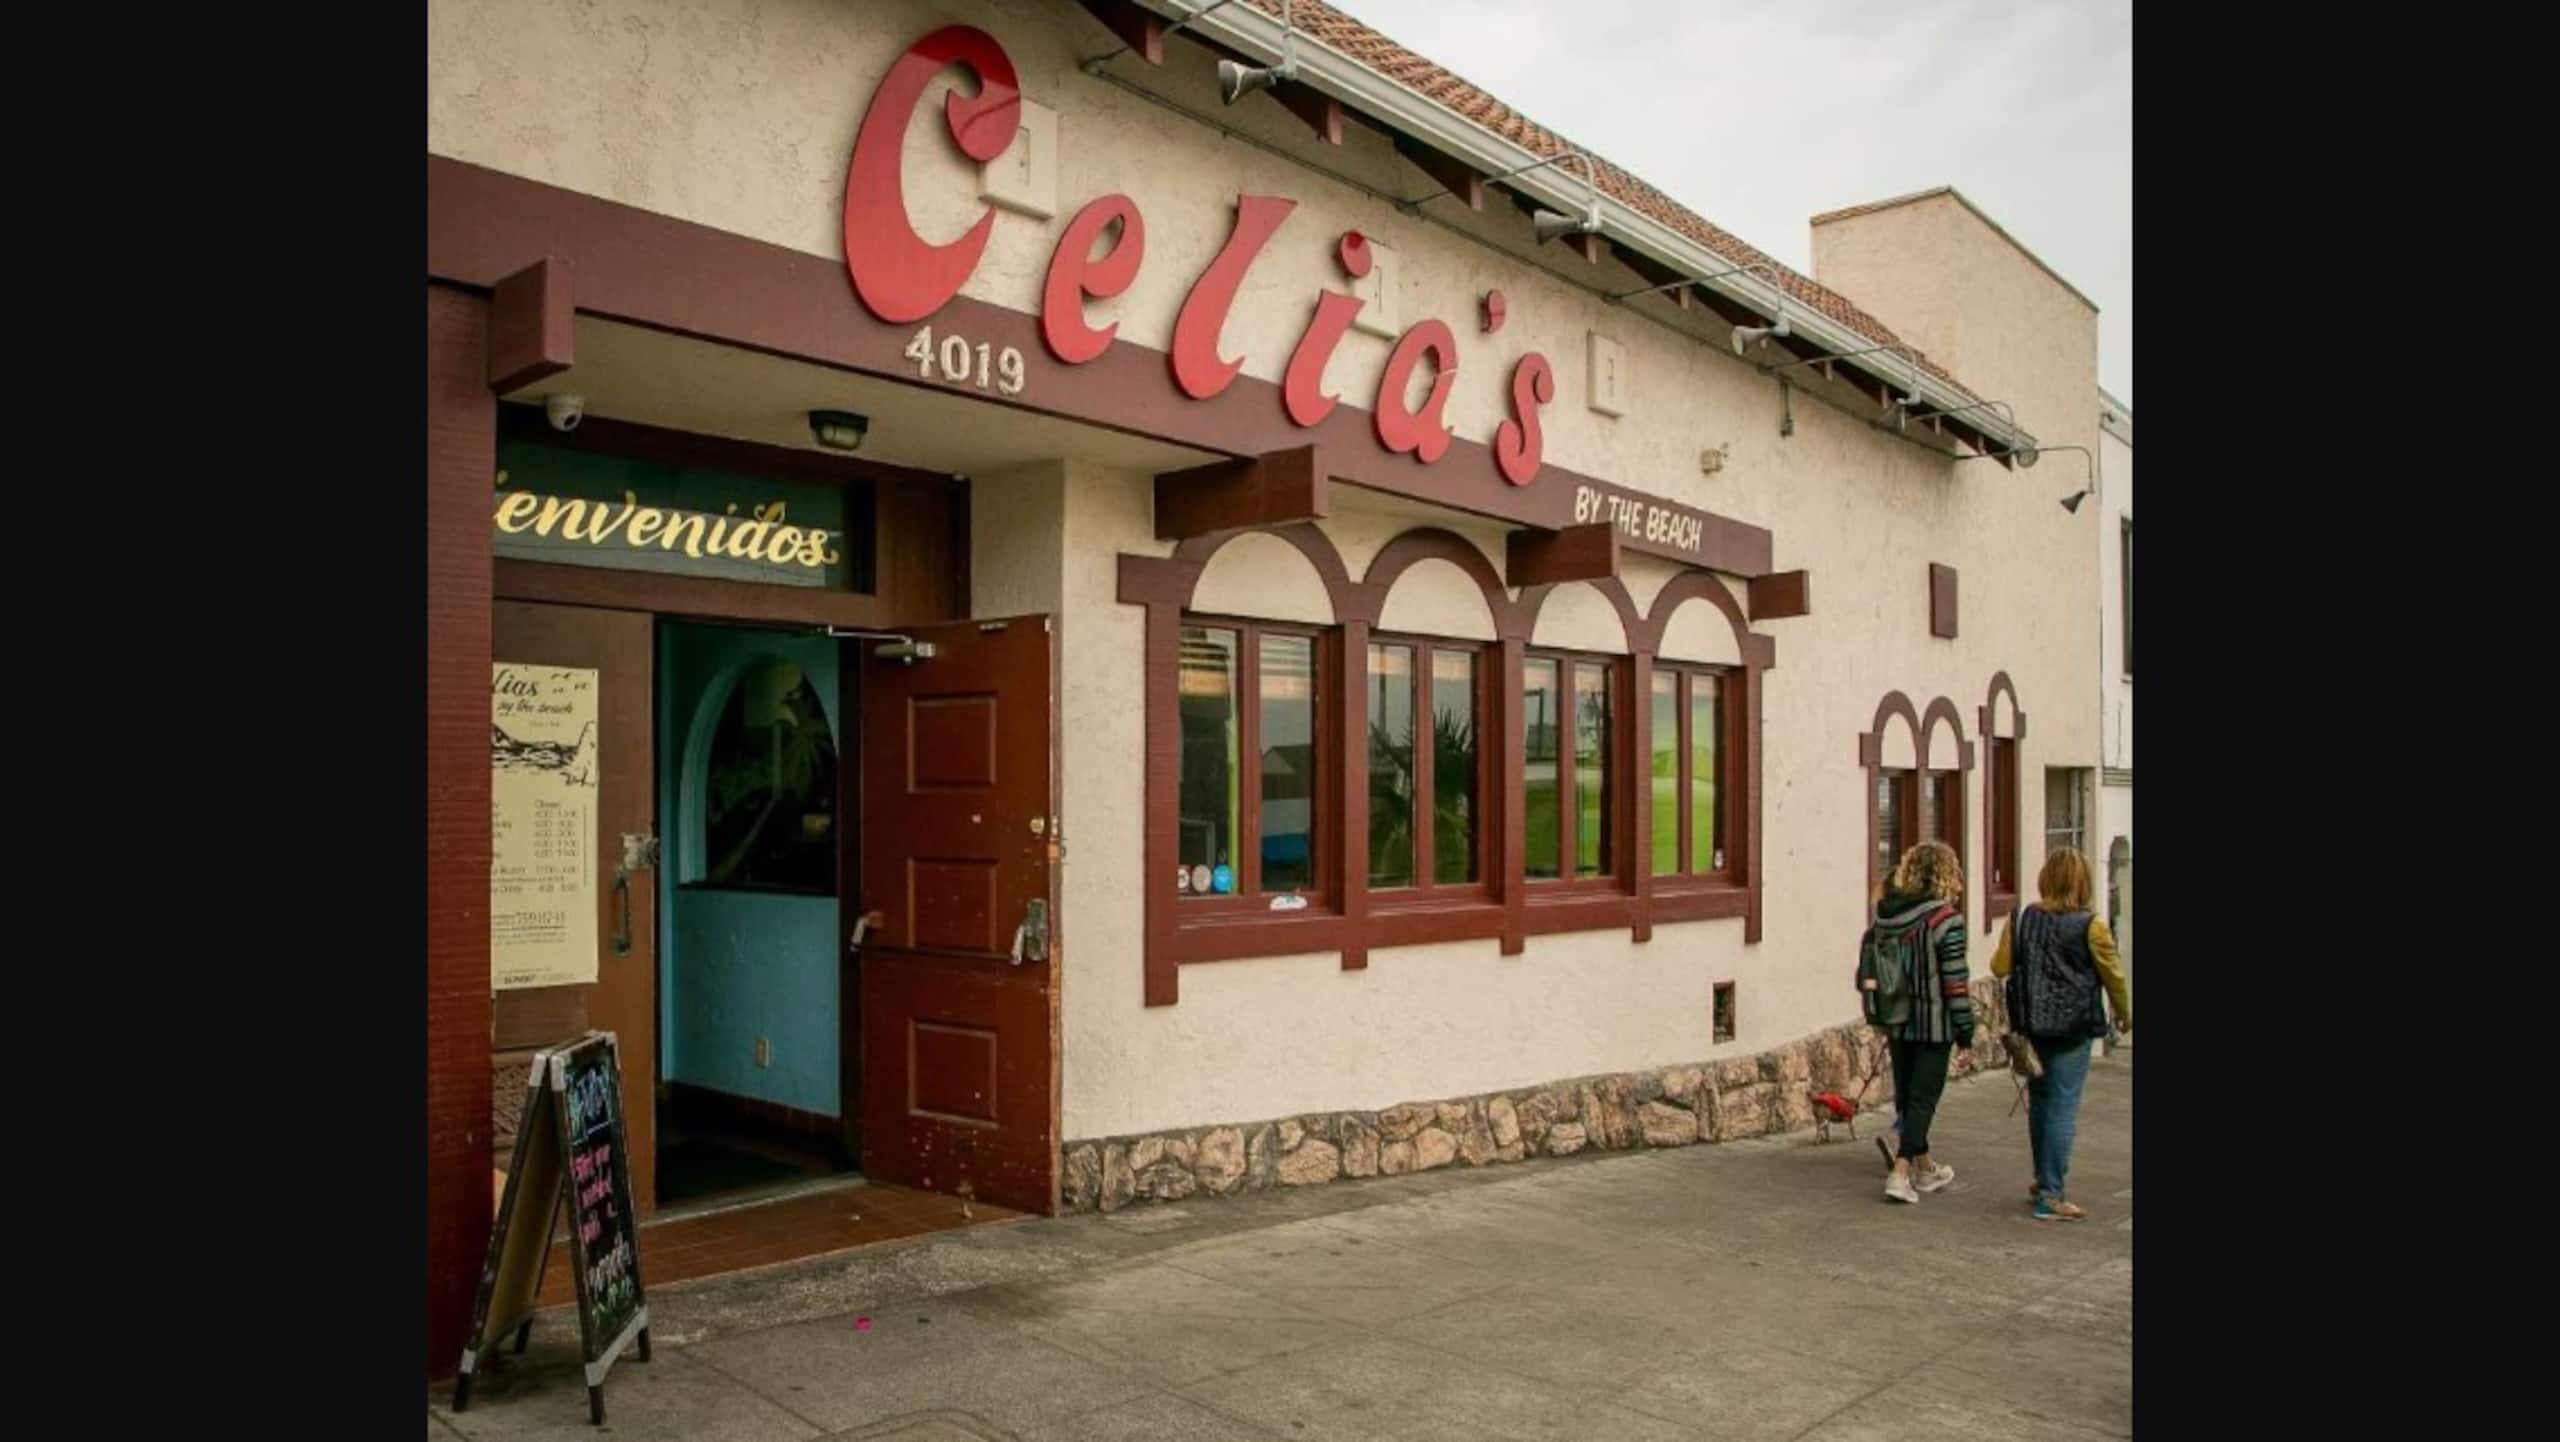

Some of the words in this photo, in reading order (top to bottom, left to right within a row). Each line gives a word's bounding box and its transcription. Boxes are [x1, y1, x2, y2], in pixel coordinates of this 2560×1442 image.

[842, 24, 1556, 487] Celia's
[905, 325, 1025, 394] 4019
[1575, 486, 1602, 523] BY
[1607, 495, 1643, 536] THE
[1646, 506, 1703, 552] BEACH
